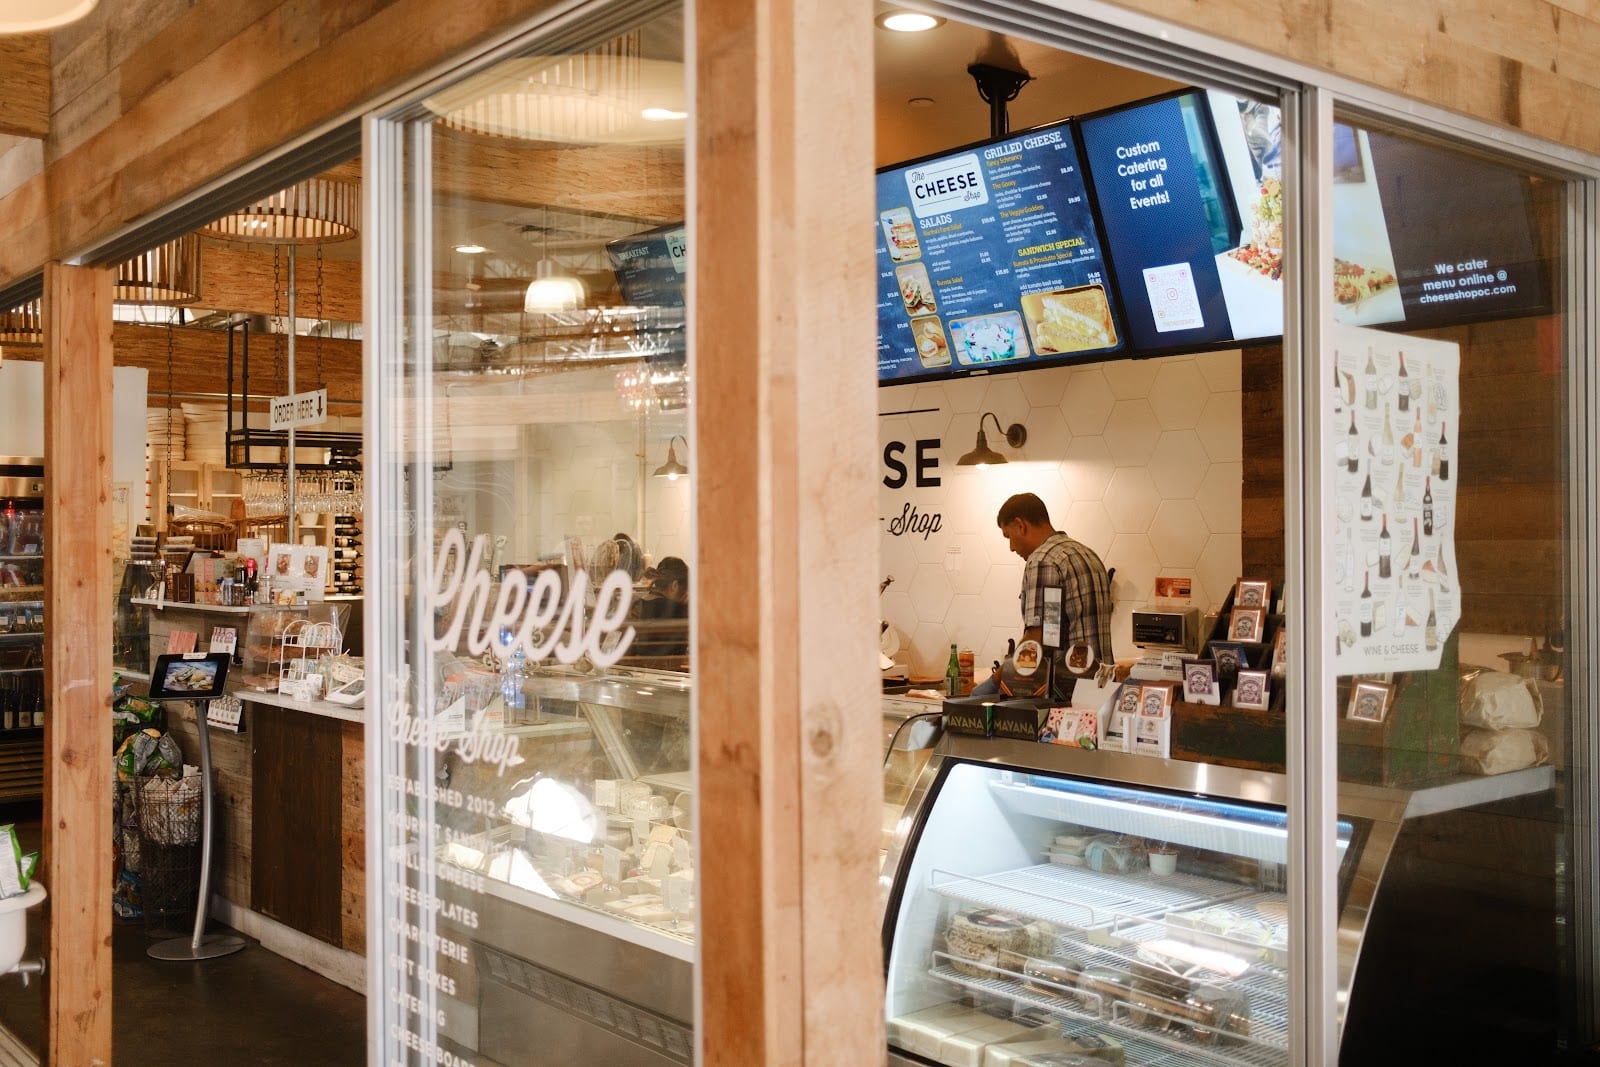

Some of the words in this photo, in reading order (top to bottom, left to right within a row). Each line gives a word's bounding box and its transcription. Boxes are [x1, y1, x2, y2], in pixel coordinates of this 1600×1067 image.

[984, 142, 1022, 159] GRILLED
[1024, 131, 1062, 150] CHEESE
[1116, 141, 1161, 159] Custom
[1117, 156, 1168, 177] Catering
[911, 171, 925, 184] The
[915, 172, 978, 199] CHEESE
[1130, 178, 1147, 192] for
[1149, 175, 1165, 188] all
[1129, 191, 1170, 210] Events!
[920, 214, 953, 229] SALADS
[1018, 243, 1055, 256] SANDWICH
[1055, 237, 1085, 249] SPECIAL
[1434, 263, 1454, 275] We
[1457, 259, 1489, 272] cater
[1423, 278, 1456, 292] menu
[1459, 273, 1494, 287] online
[1497, 270, 1508, 281] @
[1420, 283, 1517, 304] cheeseshopoc.com
[274, 402, 294, 424] ORDER
[297, 399, 313, 421] HERE
[887, 502, 942, 541] Shop
[420, 527, 636, 668] Cheese
[1390, 643, 1420, 655] CHEESE
[994, 720, 1035, 735] MAYANA
[455, 709, 526, 777] Shop
[466, 794, 496, 817] 2012
[434, 897, 479, 929] PLATES
[417, 965, 456, 996] BOXES
